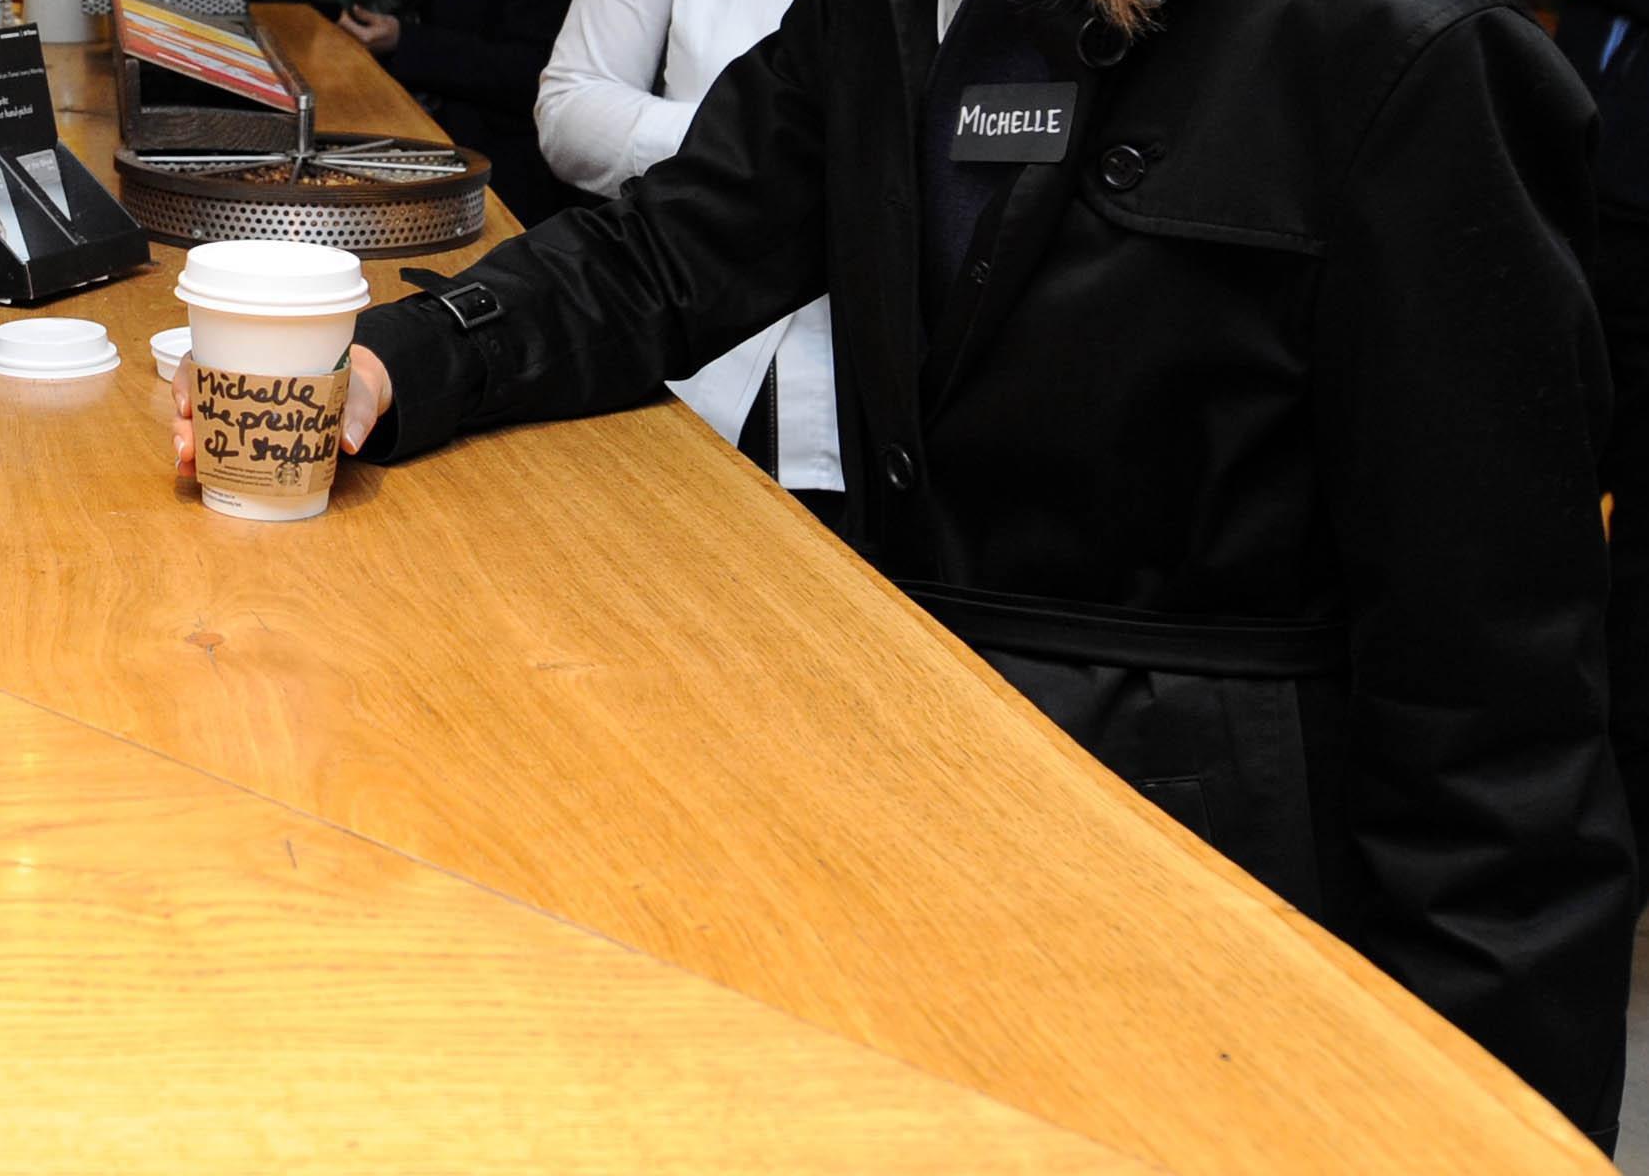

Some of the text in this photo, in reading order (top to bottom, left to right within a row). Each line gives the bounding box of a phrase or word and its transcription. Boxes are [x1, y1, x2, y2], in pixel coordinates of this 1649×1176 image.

[957, 105, 1062, 136] MICHELLE
[197, 368, 318, 407] Michelle
[197, 397, 235, 427] the
